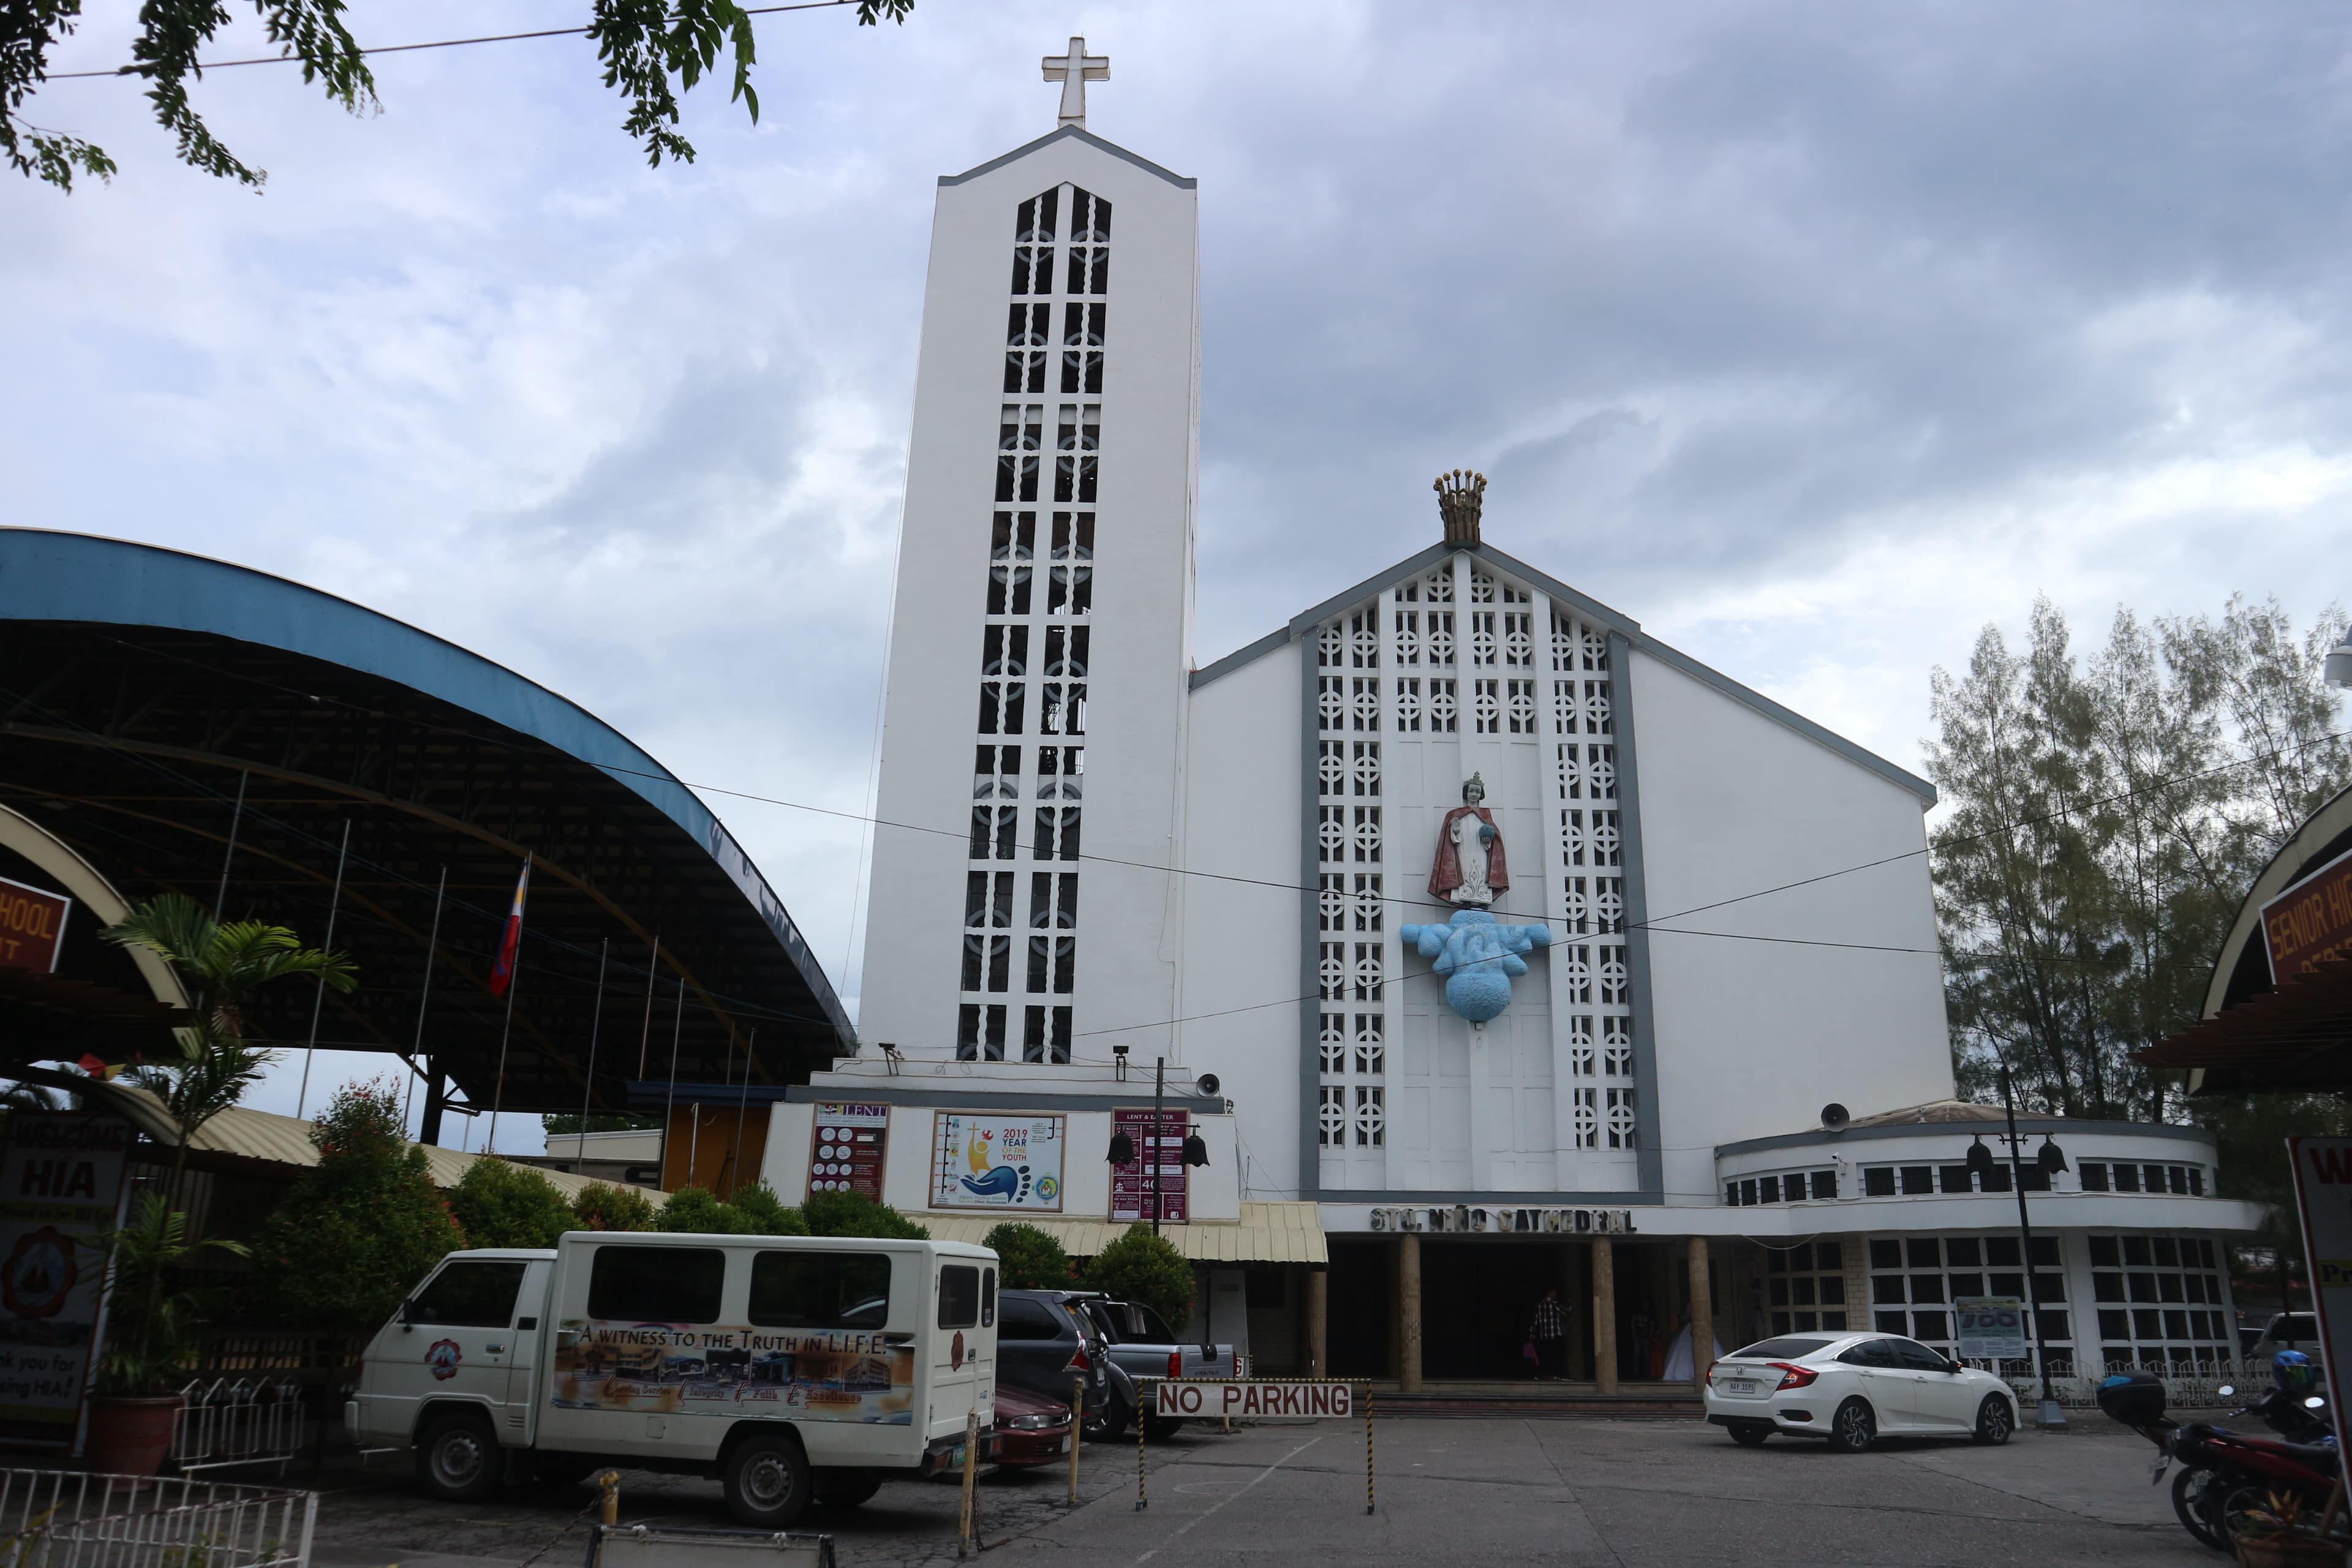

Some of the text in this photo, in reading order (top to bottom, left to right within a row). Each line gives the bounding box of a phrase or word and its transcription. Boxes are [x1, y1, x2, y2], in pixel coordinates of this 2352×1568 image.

[2269, 892, 2330, 961] SENIOR
[845, 1104, 886, 1116] LENT
[1003, 1129, 1027, 1138] 2019
[20, 1159, 96, 1198] HIA
[1371, 1205, 1637, 1232] STO. NIÑO CATHEDRAL
[579, 1325, 592, 1342] A
[599, 1329, 666, 1345] WITNESS
[673, 1332, 695, 1346] TO
[702, 1334, 733, 1348] THE
[804, 1338, 822, 1352] IN
[829, 1334, 887, 1354] L.I.F.E.
[19, 1357, 48, 1373] you
[52, 1354, 77, 1372] for
[34, 1376, 75, 1397] HIA!
[689, 1387, 725, 1399] Integrity
[753, 1388, 778, 1399] Faith
[1159, 1385, 1349, 1415] NO PARKING
